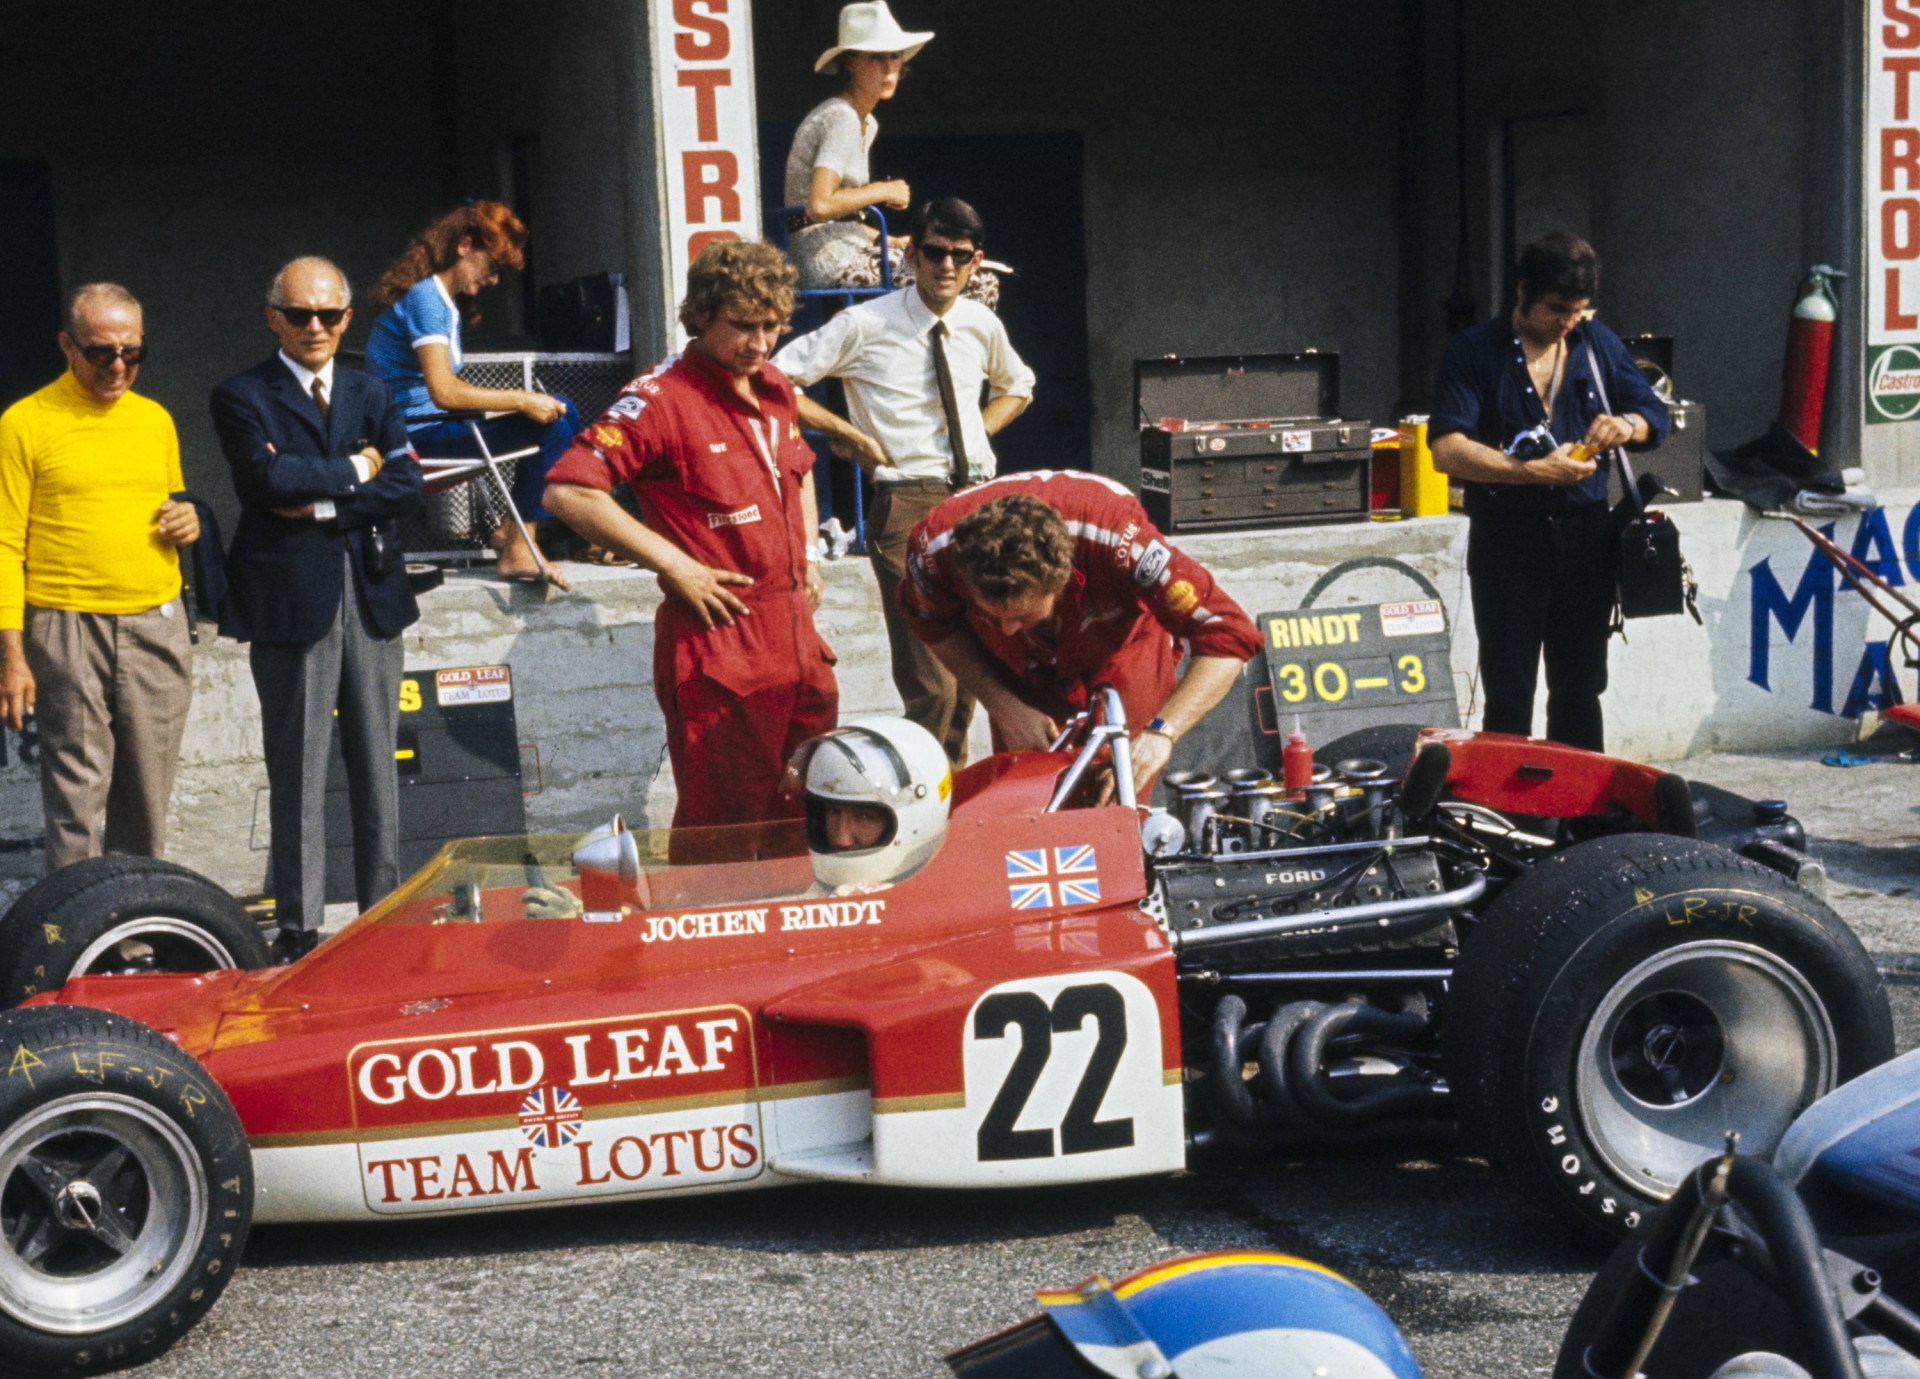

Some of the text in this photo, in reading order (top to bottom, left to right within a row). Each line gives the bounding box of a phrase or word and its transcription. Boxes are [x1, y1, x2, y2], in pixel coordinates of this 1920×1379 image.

[1142, 471, 1169, 489] Shell
[1116, 522, 1140, 568] LOTUS
[1382, 602, 1438, 616] GOLD LEAF
[1269, 613, 1361, 649] RINDT
[440, 669, 505, 683] GOLD LEAF
[442, 688, 508, 700] TEAM LOTUS
[1266, 870, 1325, 884] FORD
[641, 900, 886, 942] JOCHEN RINDT
[358, 1019, 738, 1104] GOLD LEAF
[974, 982, 1135, 1161] 22
[368, 1124, 759, 1203] TEAM LOTUS
[1541, 1094, 1641, 1228] estone
